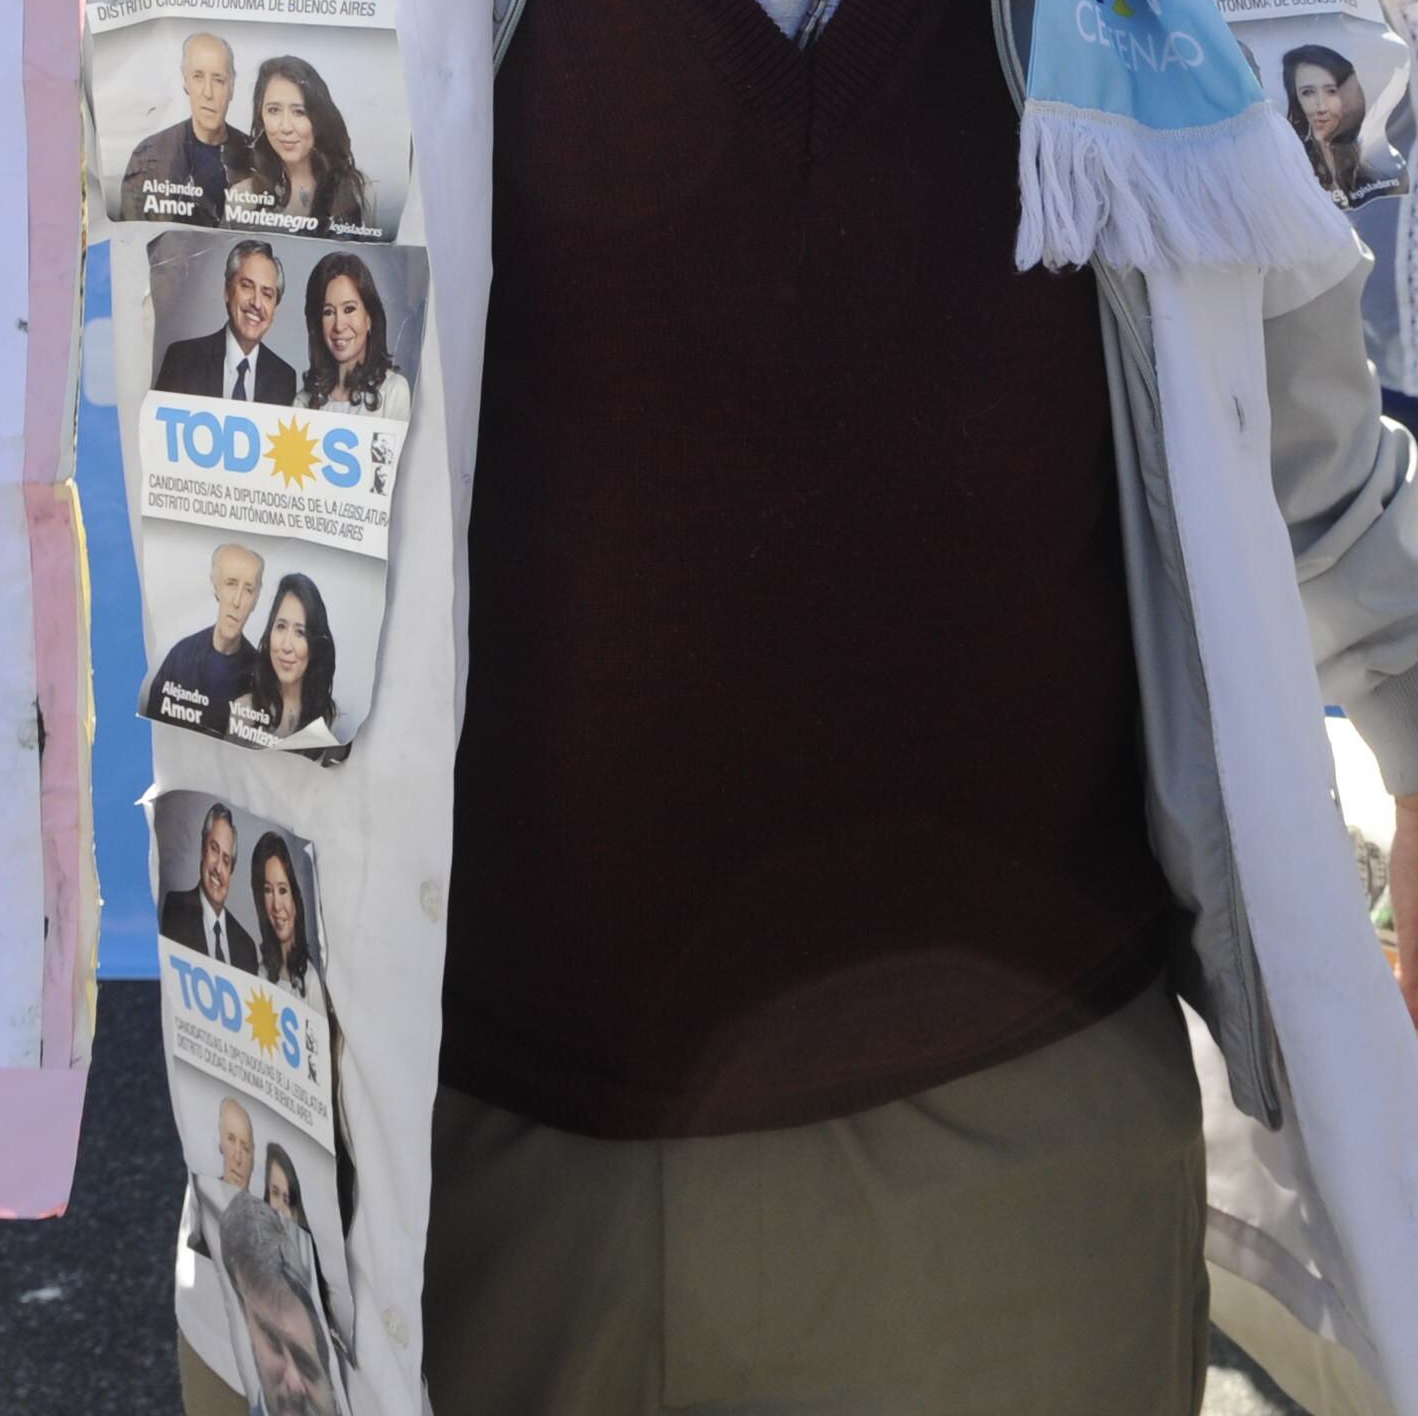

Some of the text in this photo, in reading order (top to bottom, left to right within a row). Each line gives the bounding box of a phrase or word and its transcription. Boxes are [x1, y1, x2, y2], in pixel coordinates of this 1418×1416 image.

[339, 0, 376, 17] AIRES
[143, 195, 196, 218] Amor
[224, 188, 275, 206] Victoria
[224, 204, 319, 232] Montenegro
[148, 473, 223, 500] CANDIDATOS/AS
[224, 487, 232, 501] A
[233, 486, 305, 512] DIPUTADOS/AS
[307, 497, 323, 514] DE
[323, 499, 337, 517] LA
[148, 491, 364, 542] DISTRITO CIUDAD AUTÓNOMA DE BUENOS AIRES
[161, 680, 210, 706] Alejandro
[160, 696, 203, 725] Amor
[229, 700, 271, 725] Victoria
